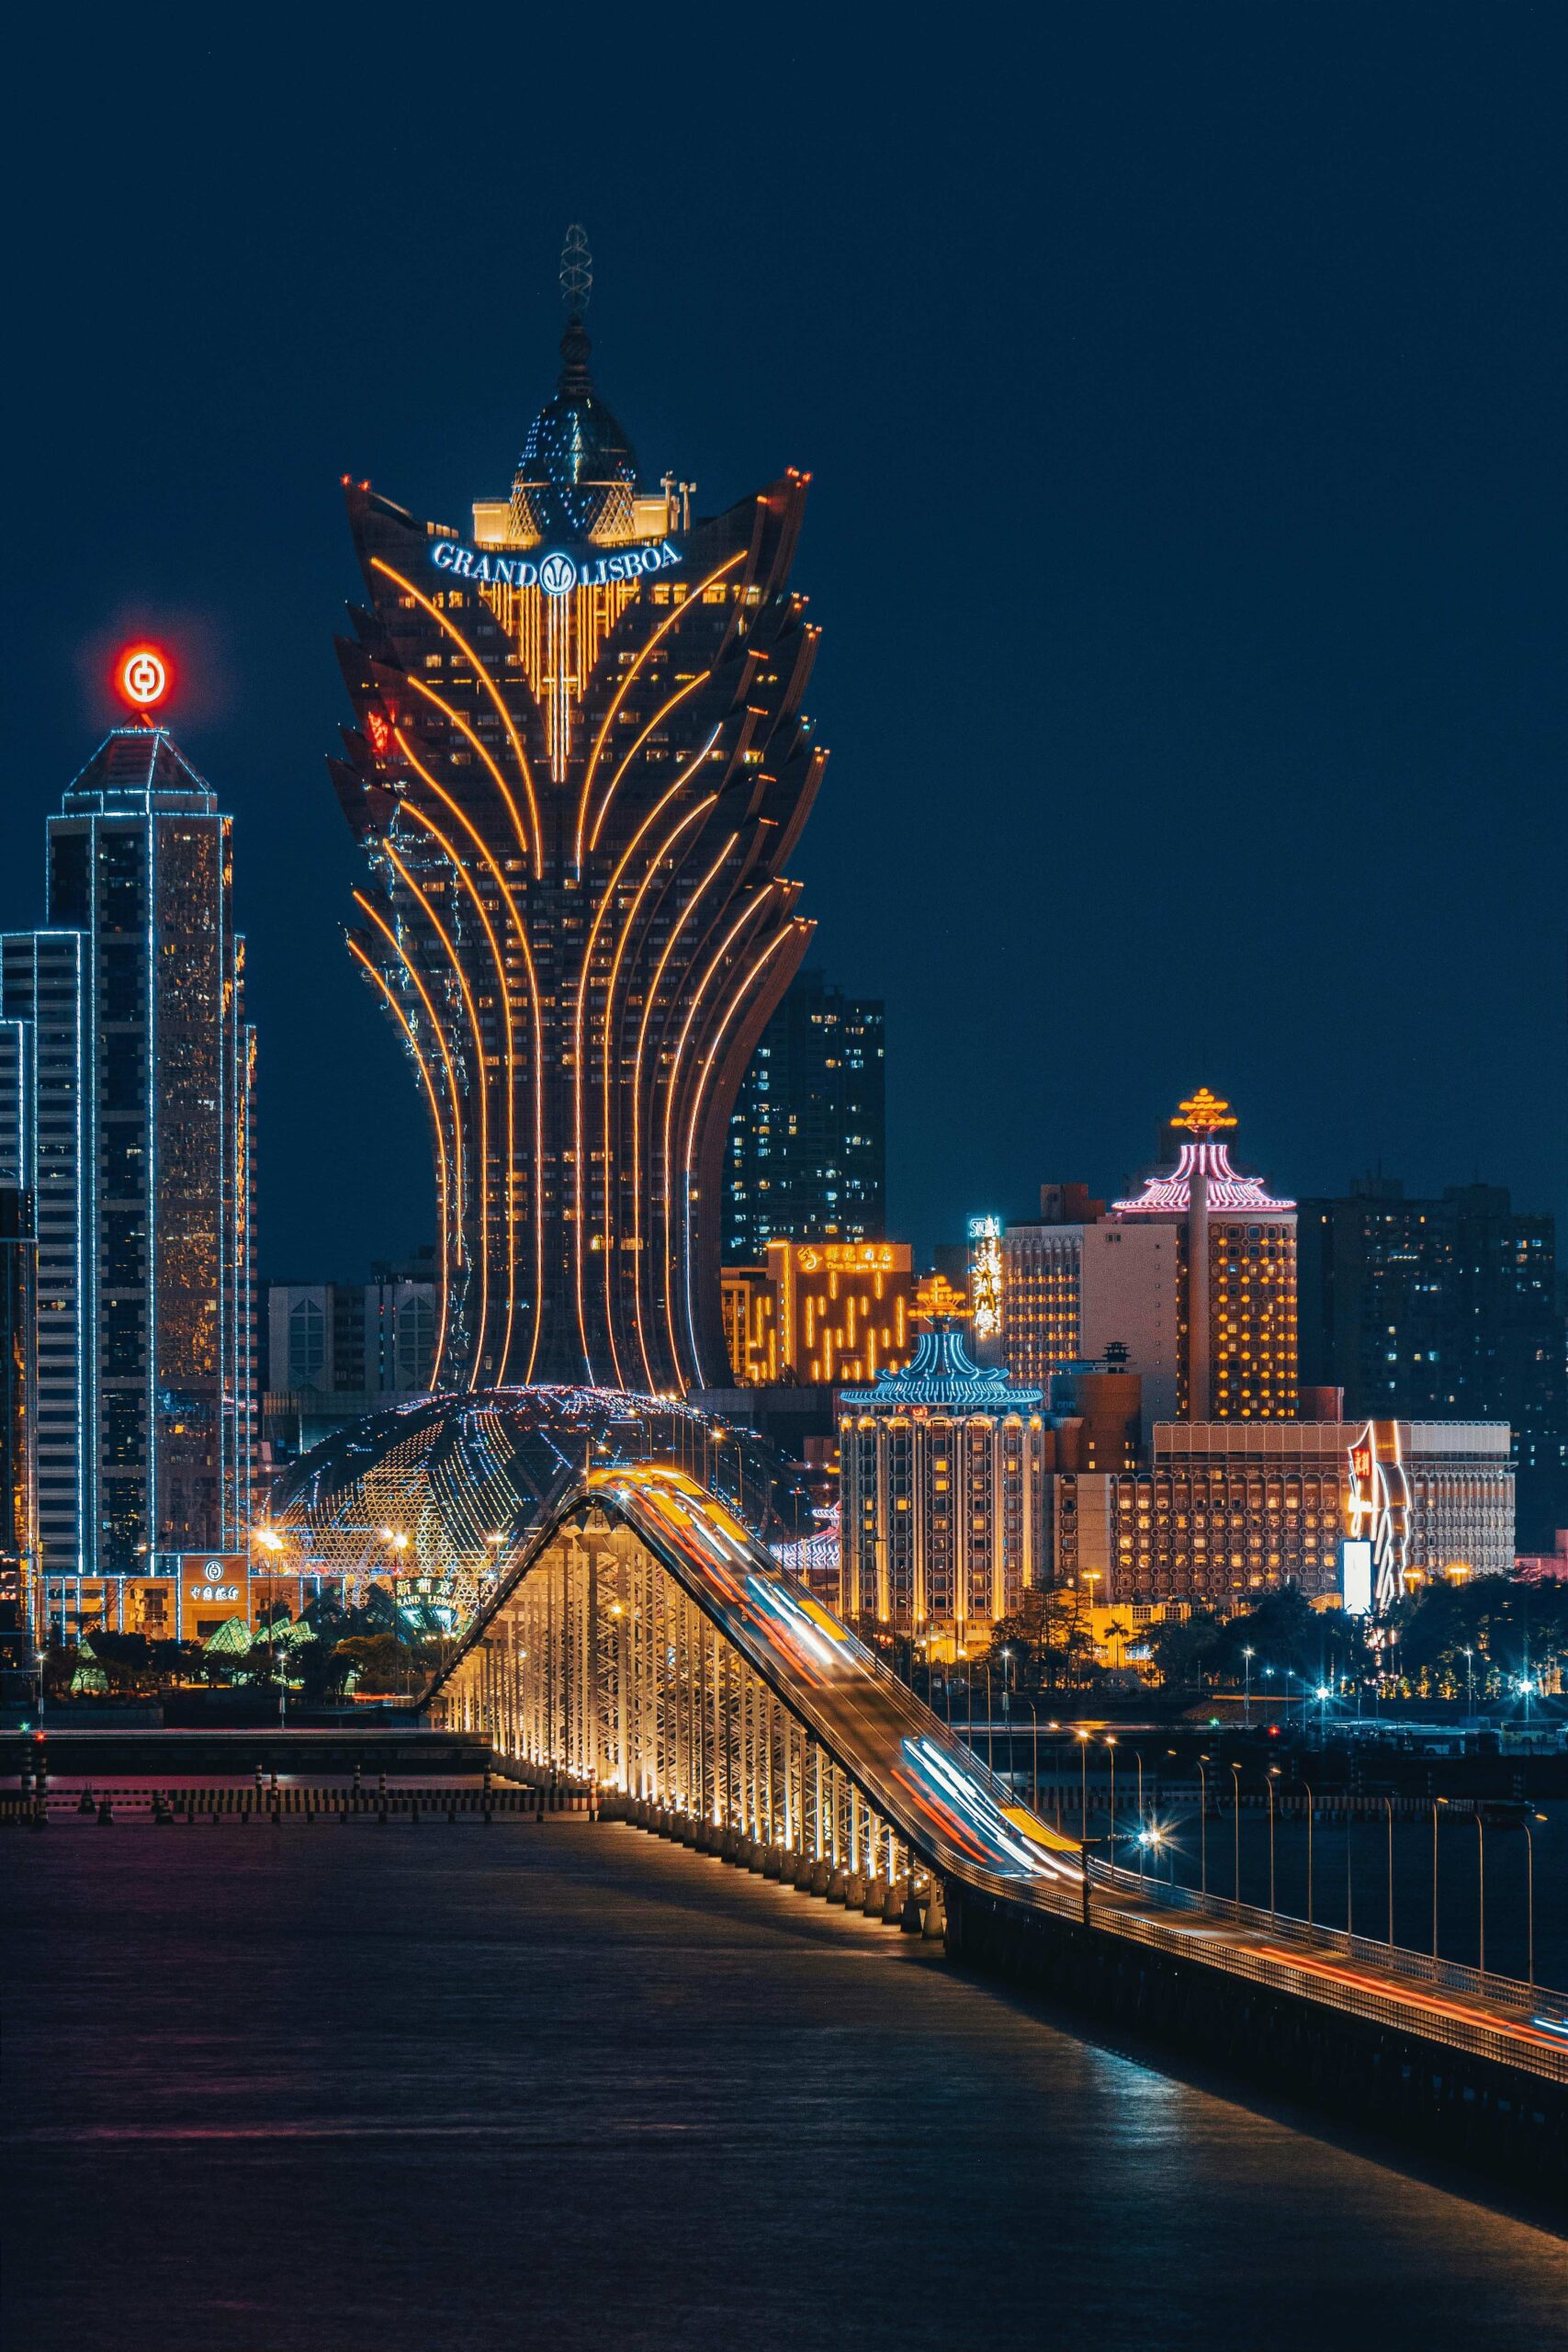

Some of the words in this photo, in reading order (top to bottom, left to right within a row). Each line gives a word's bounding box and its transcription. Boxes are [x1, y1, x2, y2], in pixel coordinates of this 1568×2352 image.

[433, 541, 538, 587] GRAND
[579, 540, 682, 587] LISBOA
[396, 1577, 455, 1597] 新葡京
[396, 1595, 422, 1608] RAND
